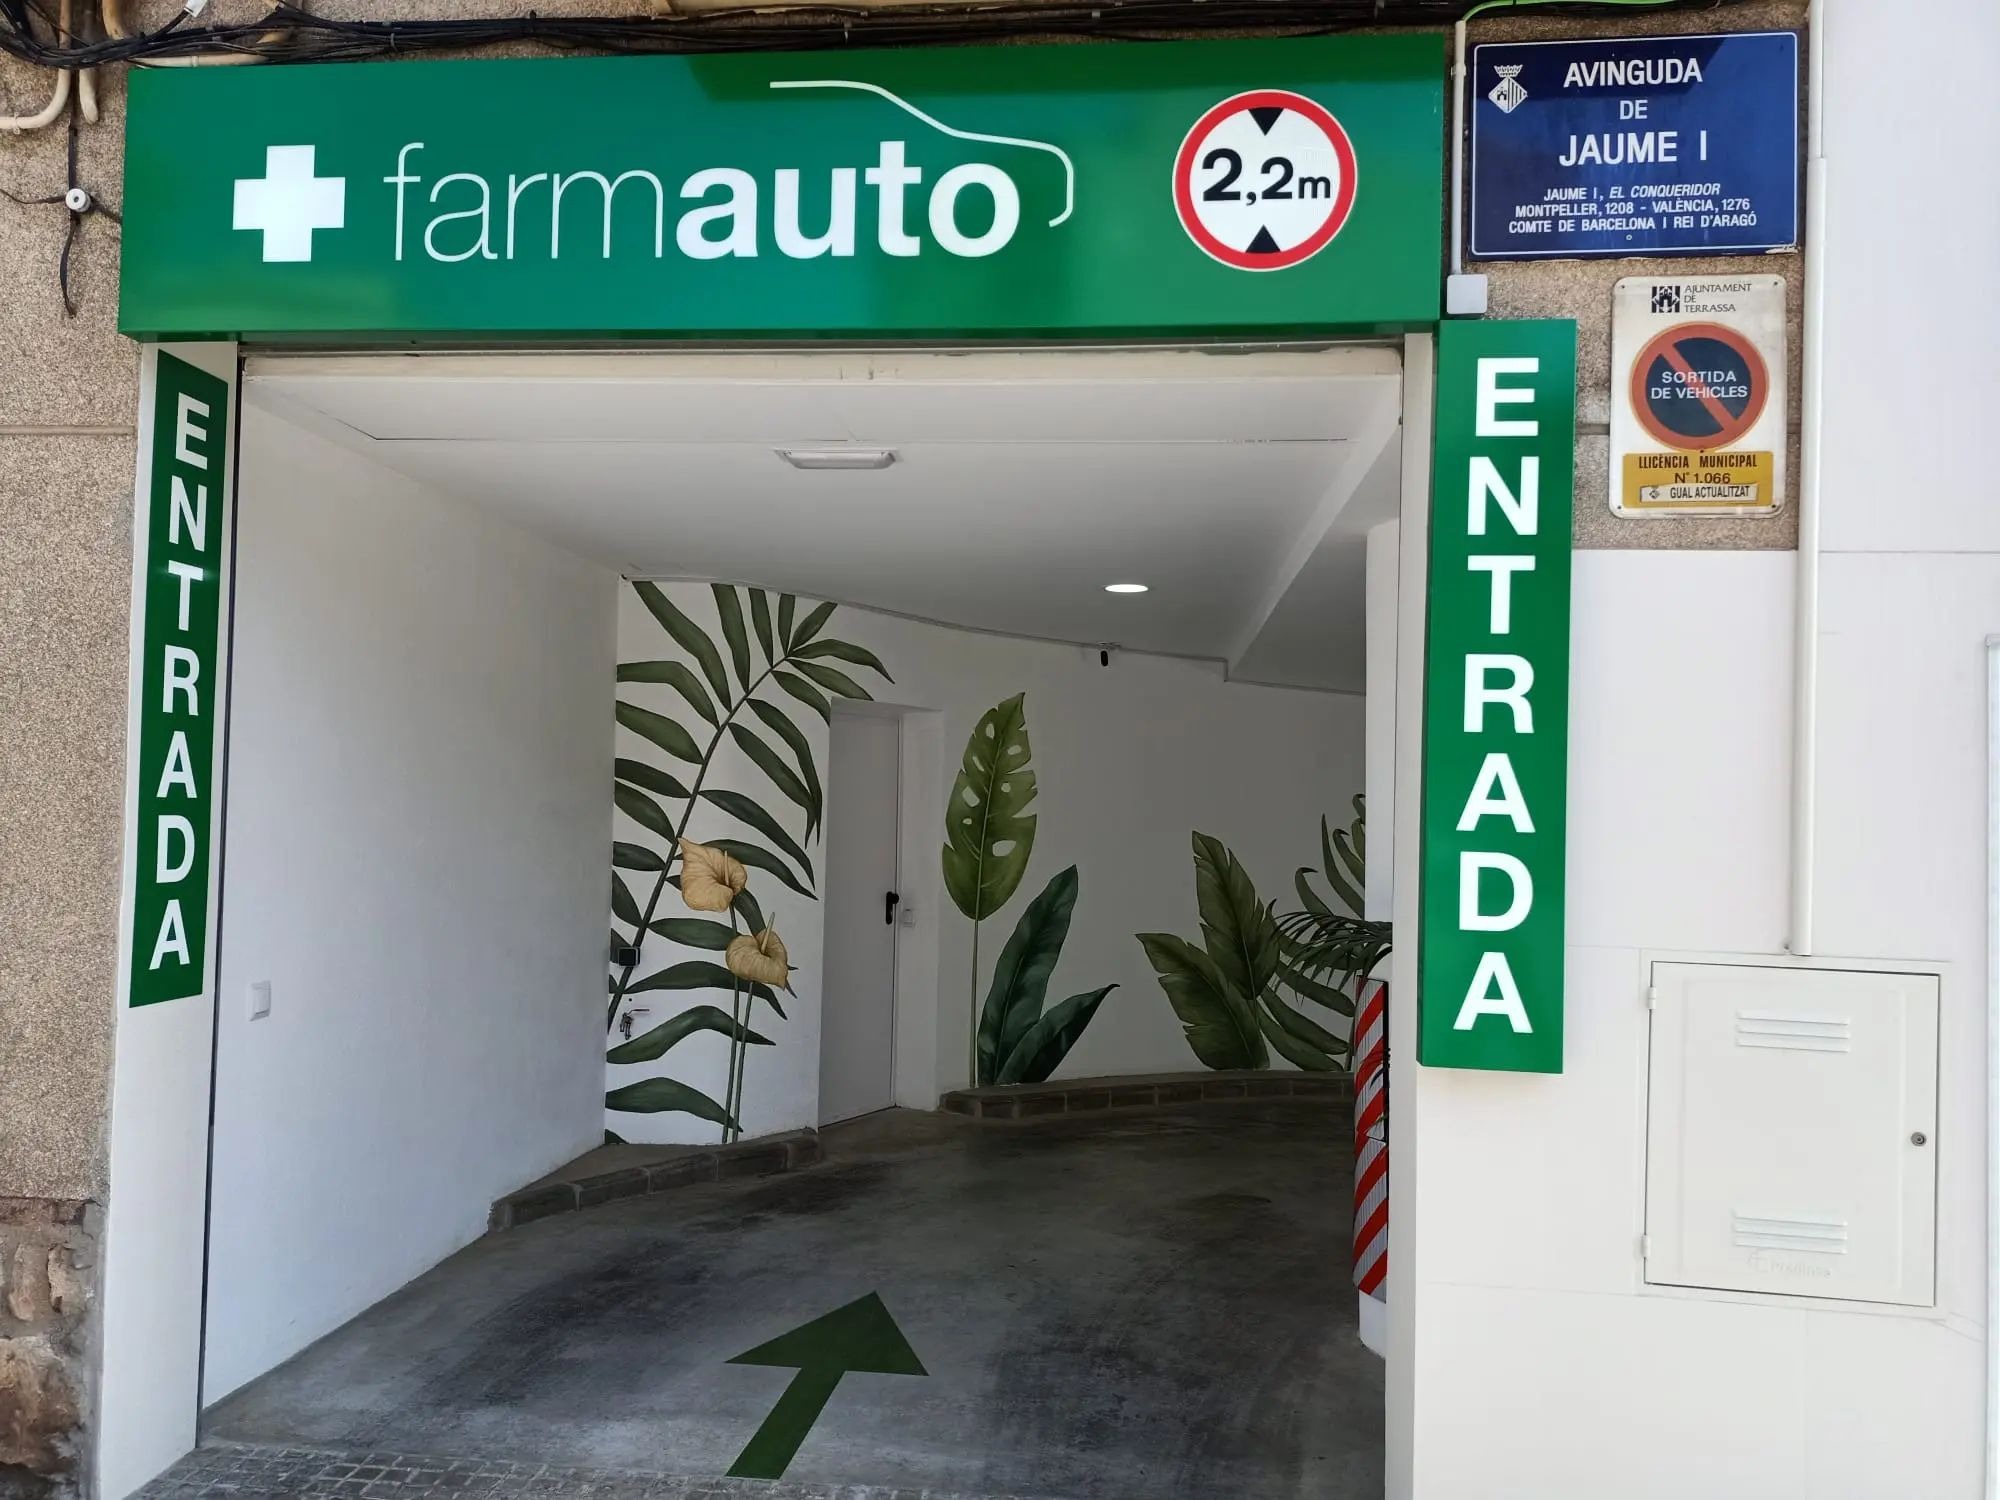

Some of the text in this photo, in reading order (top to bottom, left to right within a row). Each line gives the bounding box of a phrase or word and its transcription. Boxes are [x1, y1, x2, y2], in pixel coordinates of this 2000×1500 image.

[1563, 57, 1703, 88] AVINGUDA
[1619, 100, 1648, 120] DE
[1559, 130, 1707, 167] JAUME I
[383, 140, 1020, 260] farmauto
[1543, 187, 1587, 201] JAUME
[1609, 186, 1625, 199] EL
[1630, 183, 1721, 198] CONQUERIDOR
[1508, 211, 1757, 233] COMTE DE BARCELONA I REI D'ARAGÓ
[1684, 283, 1752, 294] AJUNTAMENT
[1684, 295, 1696, 303] DE
[1684, 304, 1736, 313] TERRASSA
[1662, 371, 1737, 383] SORTIDA
[1651, 386, 1748, 399] DE VEHICLES
[1700, 454, 1758, 468] MUNICIPAL
[1694, 472, 1731, 484] 1.066
[1670, 486, 1750, 499] GUAL ACTUALITZAT
[148, 391, 211, 971] ENTRADA
[1453, 357, 1540, 1035] ENTRADA
